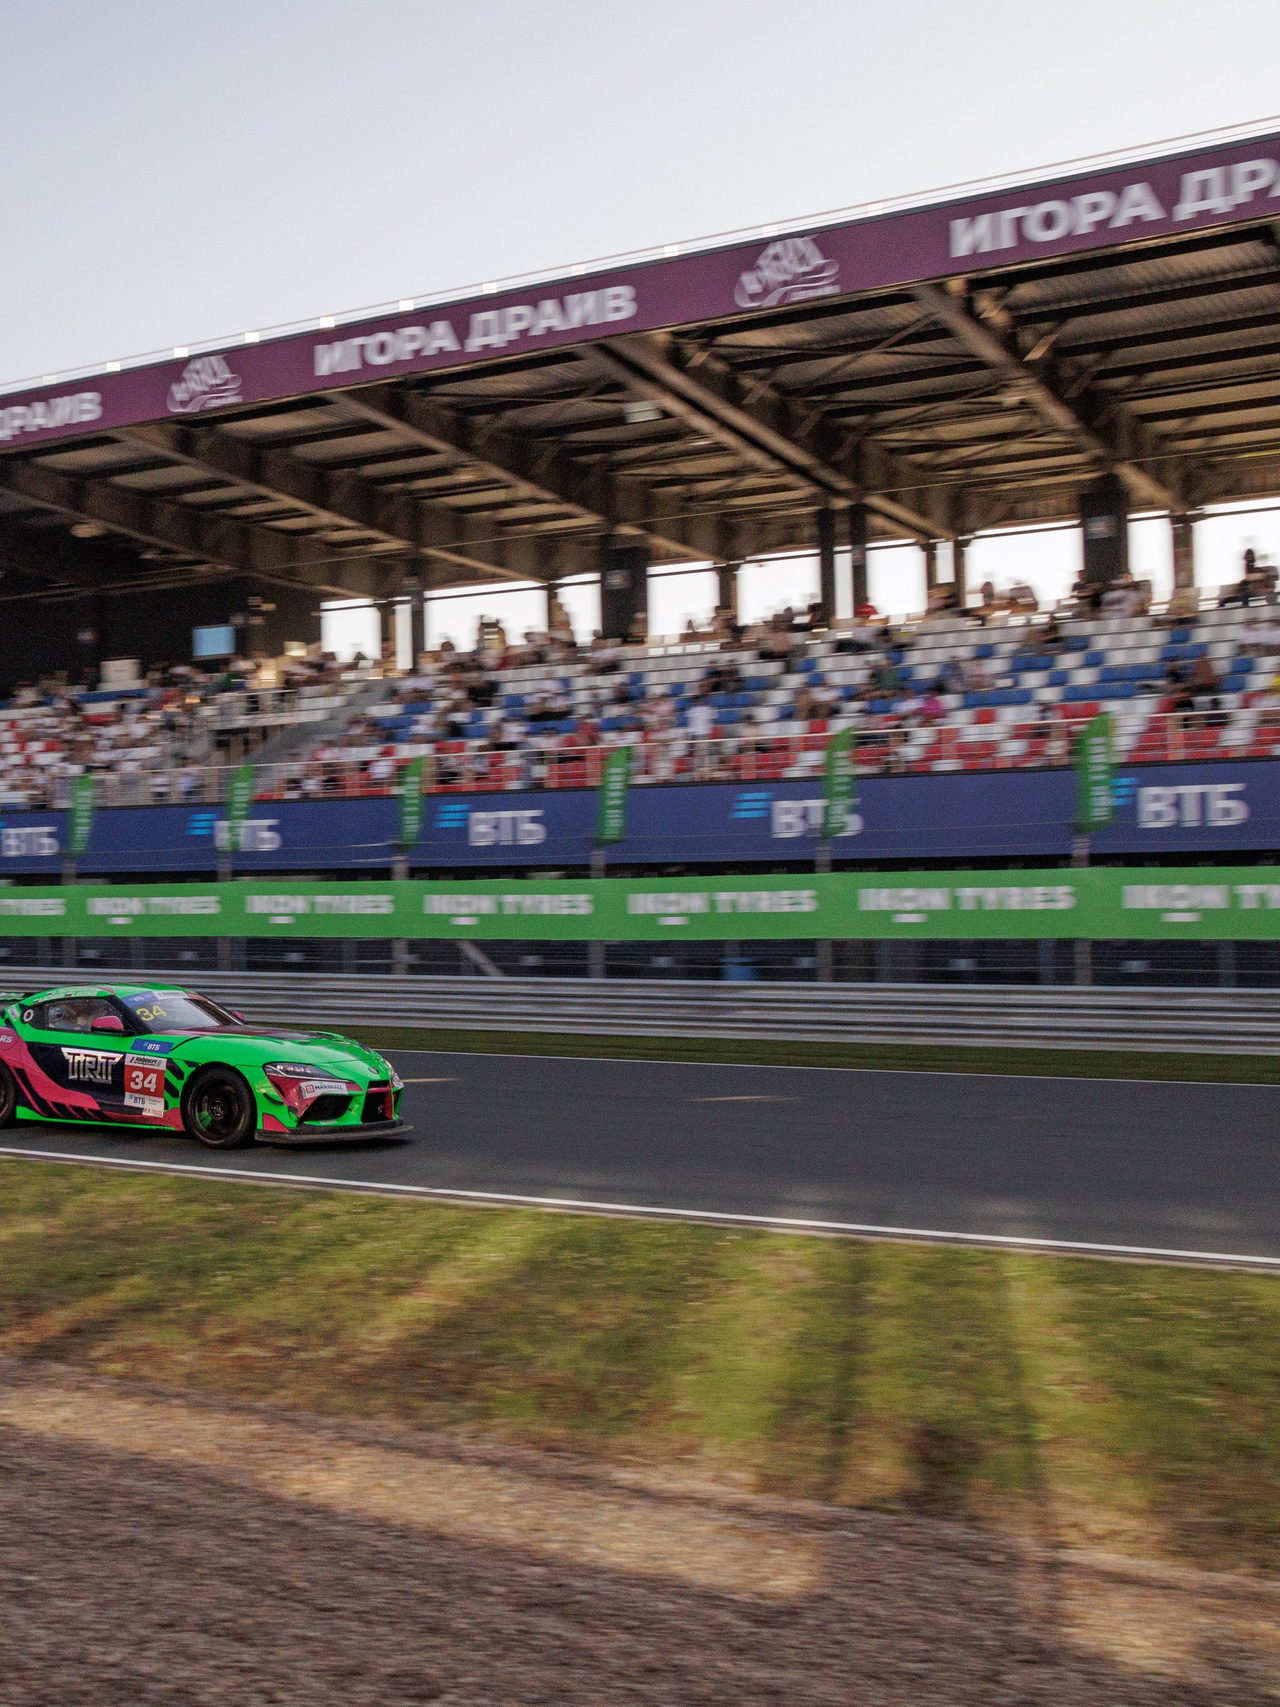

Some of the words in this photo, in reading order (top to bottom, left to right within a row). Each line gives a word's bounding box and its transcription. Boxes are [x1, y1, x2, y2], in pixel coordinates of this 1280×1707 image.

[949, 183, 1167, 259] ИГОРА
[314, 320, 462, 376] ИГОРА
[1137, 783, 1250, 828] ВТБ
[467, 810, 548, 847] ВТБ
[136, 1005, 167, 1021] 34
[147, 1043, 160, 1051] ВТБ
[130, 1071, 158, 1092] 34
[133, 1096, 146, 1104] ВТБ
